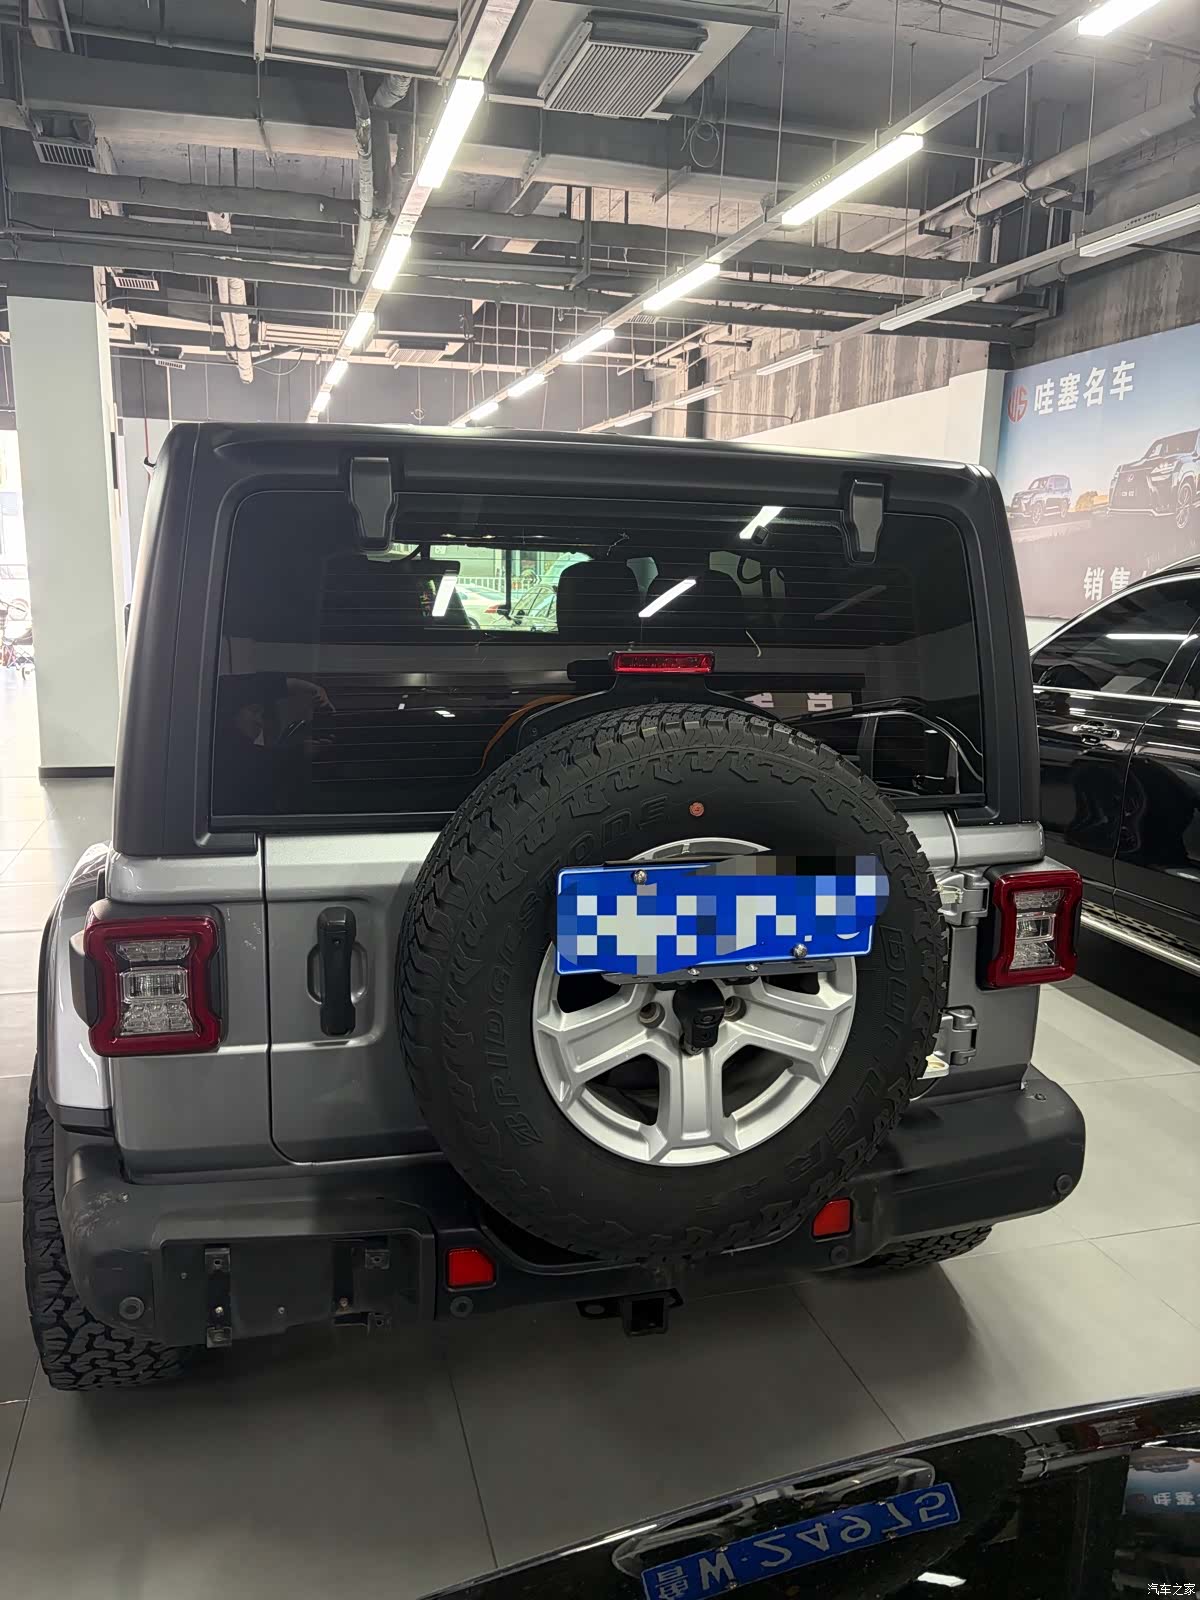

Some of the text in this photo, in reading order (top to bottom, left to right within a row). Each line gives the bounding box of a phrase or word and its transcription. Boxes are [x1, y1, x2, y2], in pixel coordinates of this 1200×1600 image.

[1034, 361, 1135, 415] 哇塞名车
[1083, 566, 1161, 601] 销售
